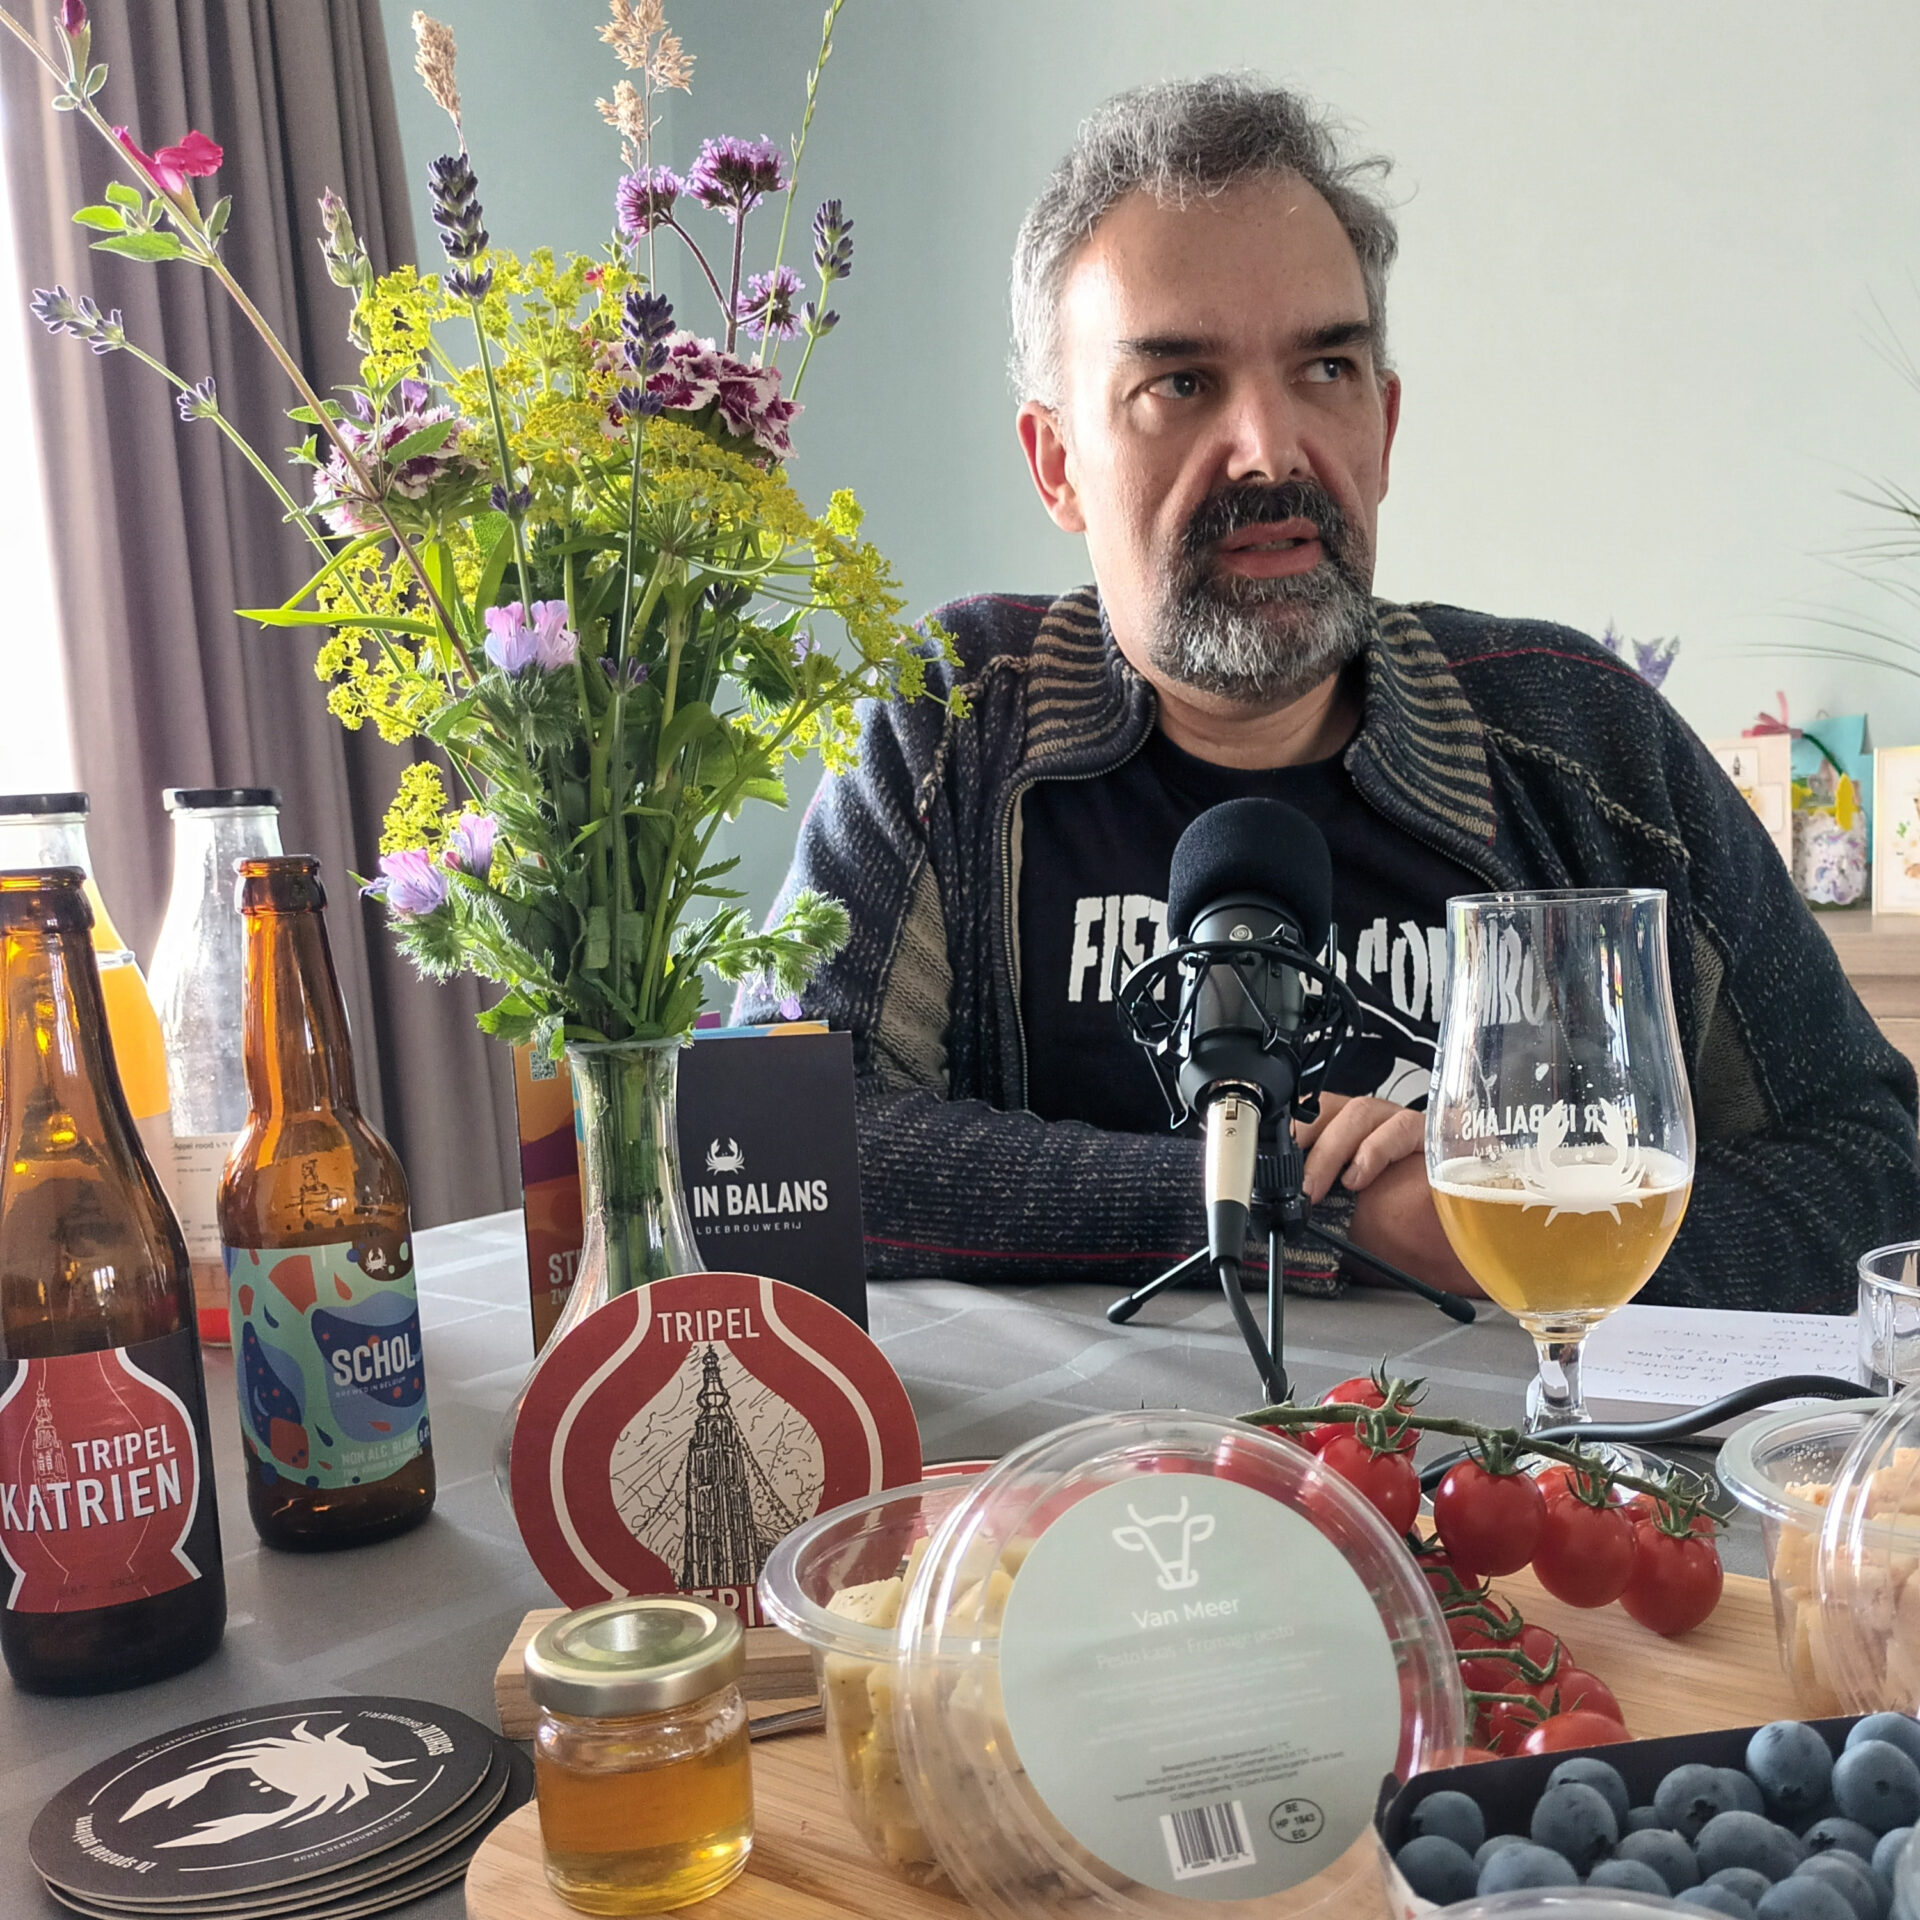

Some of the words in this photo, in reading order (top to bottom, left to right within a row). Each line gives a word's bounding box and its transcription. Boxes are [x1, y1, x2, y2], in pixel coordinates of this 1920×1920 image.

[693, 1185, 720, 1218] IN
[726, 1179, 829, 1217] BALANS
[695, 1221, 803, 1236] LDEBROUWERIJ
[656, 1307, 761, 1344] TRIPEL
[331, 1332, 417, 1387] SCHOL
[71, 1424, 177, 1474] TRIPEL
[0, 1458, 184, 1533] KATRIEN
[1131, 1608, 1179, 1630] Van
[1182, 1598, 1241, 1622] Meer
